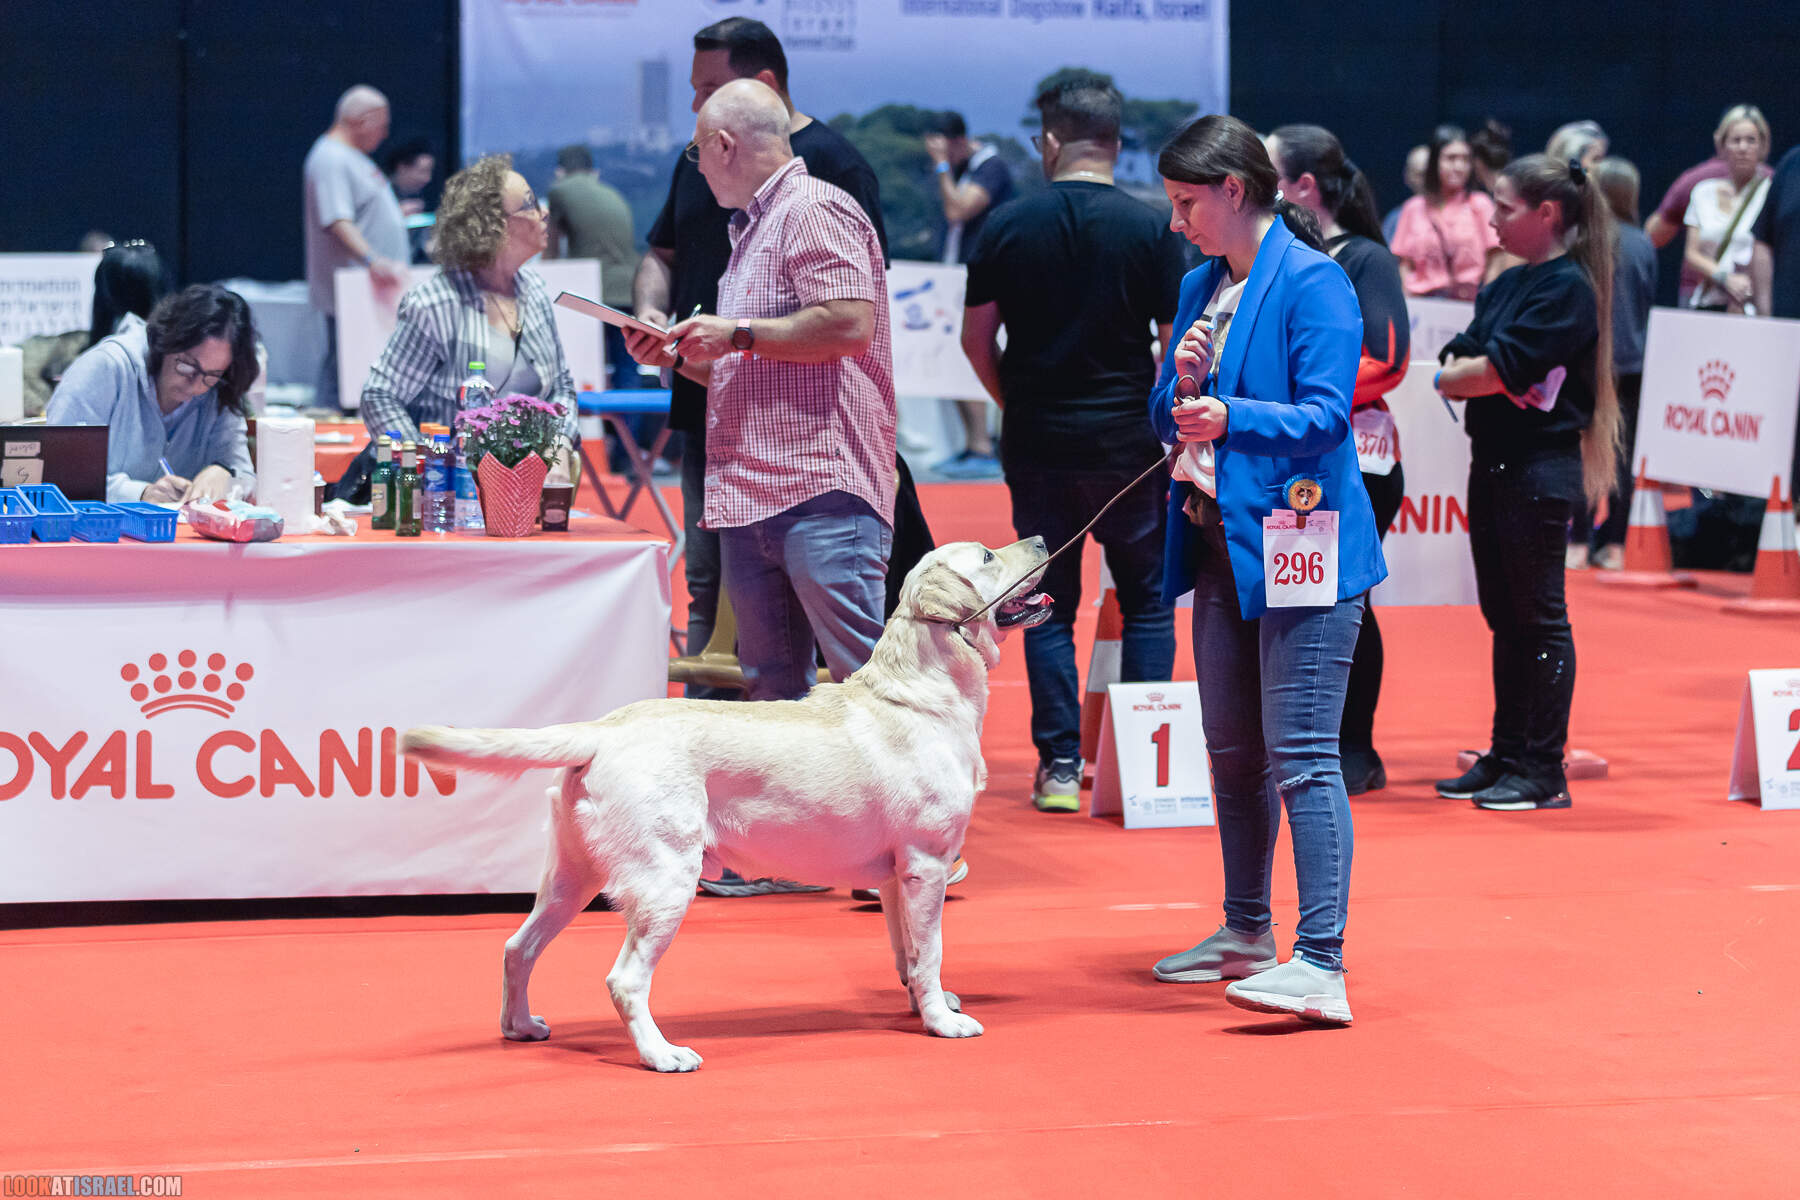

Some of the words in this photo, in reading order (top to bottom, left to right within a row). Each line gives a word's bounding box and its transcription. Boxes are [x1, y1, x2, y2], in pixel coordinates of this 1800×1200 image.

[1664, 403, 1707, 435] ROYAL
[1711, 410, 1760, 442] CANIN
[1357, 432, 1388, 460] 370
[1389, 495, 1469, 534] NIN
[1273, 552, 1325, 586] 296
[1132, 704, 1157, 712] ROYAL
[1151, 722, 1171, 788] 1
